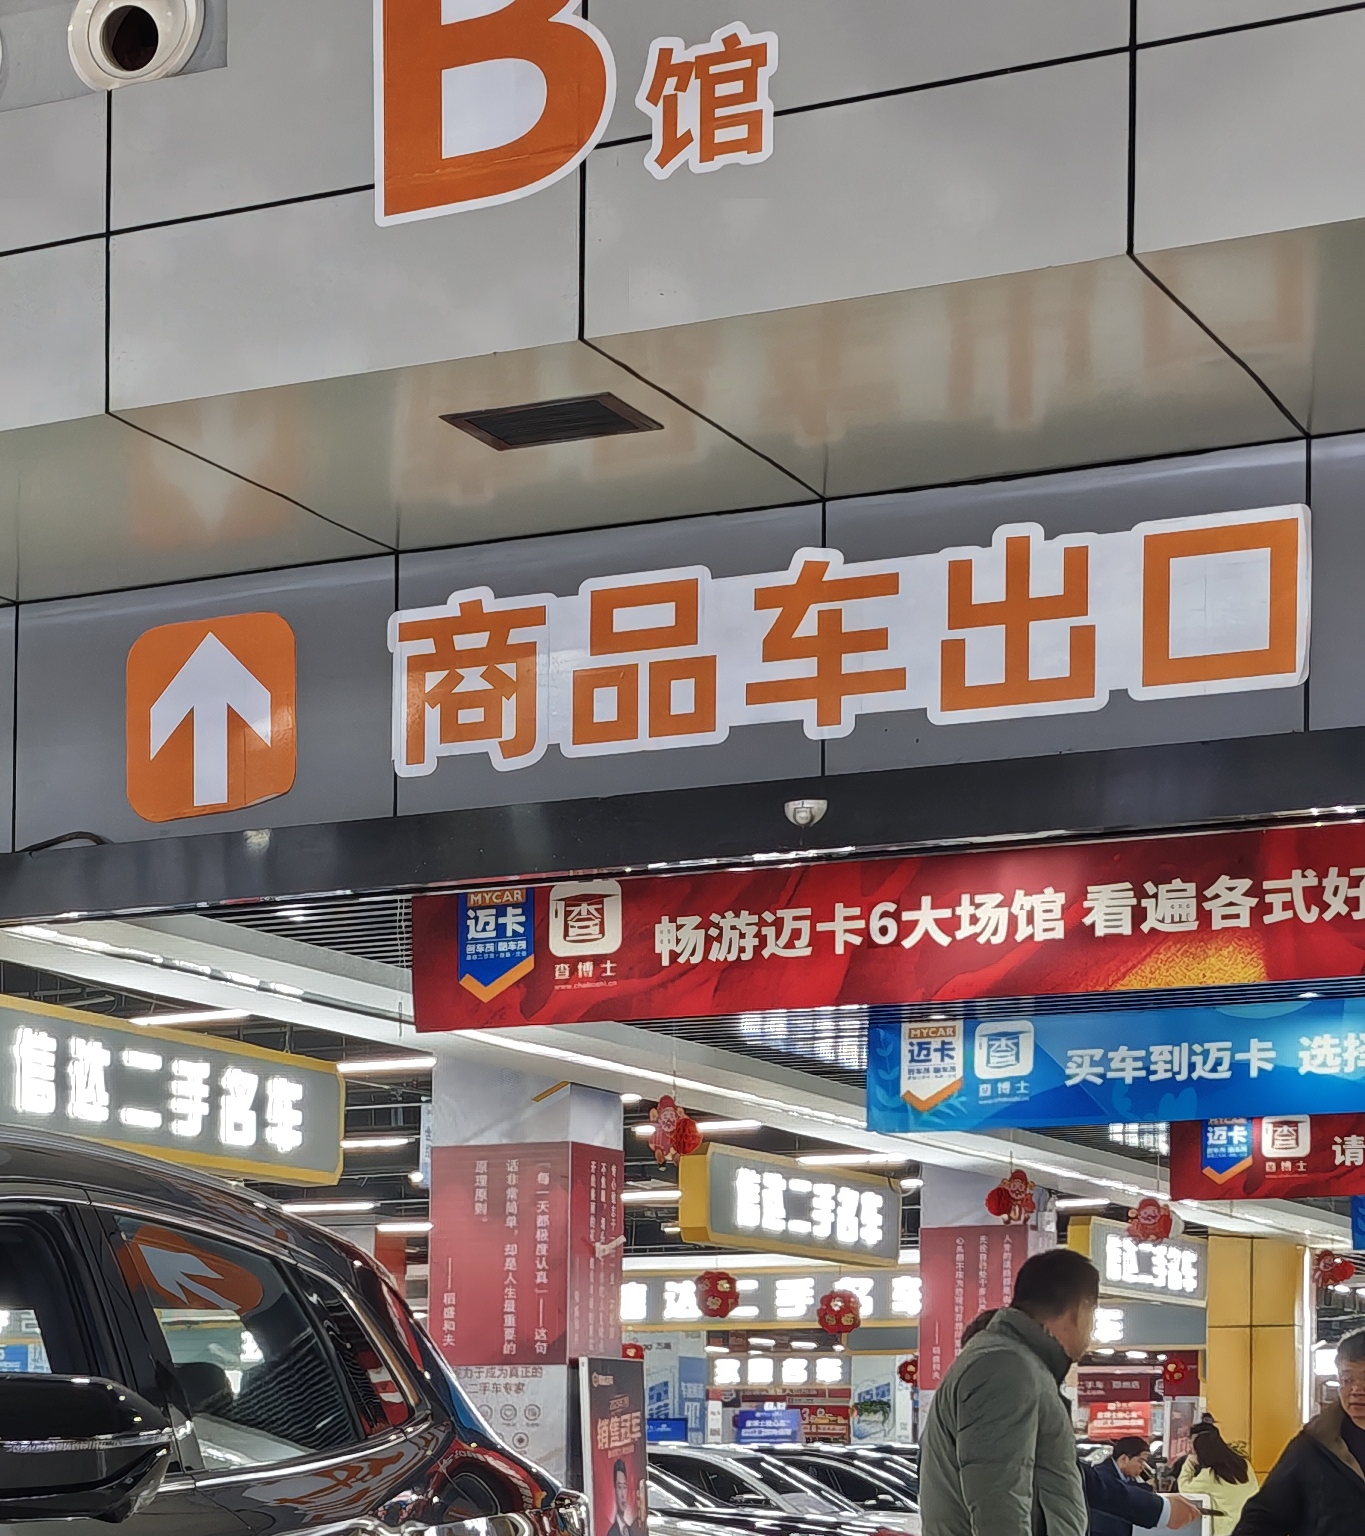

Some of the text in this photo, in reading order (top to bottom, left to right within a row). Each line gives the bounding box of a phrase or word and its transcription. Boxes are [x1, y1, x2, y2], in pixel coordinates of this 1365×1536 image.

[377, 0, 774, 222] B 馆
[399, 510, 1305, 768] 商品车出口
[469, 889, 523, 905] MYCAR
[467, 906, 526, 941] 迈卡
[654, 866, 1365, 967] 畅游迈卡6大场馆 看遍各式好
[554, 960, 618, 980] 查博士
[909, 1027, 955, 1039] MYCAR
[907, 1040, 957, 1064] 迈卡
[1065, 1037, 1277, 1088] 买车到迈卡
[11, 1024, 306, 1154] 信达二手名车
[978, 1081, 1030, 1097] 查博士
[1206, 1125, 1248, 1146] 迈卡
[1331, 1134, 1365, 1167] 请
[1265, 1160, 1308, 1173] 查博士
[468, 1382, 527, 1396] 二手车专家
